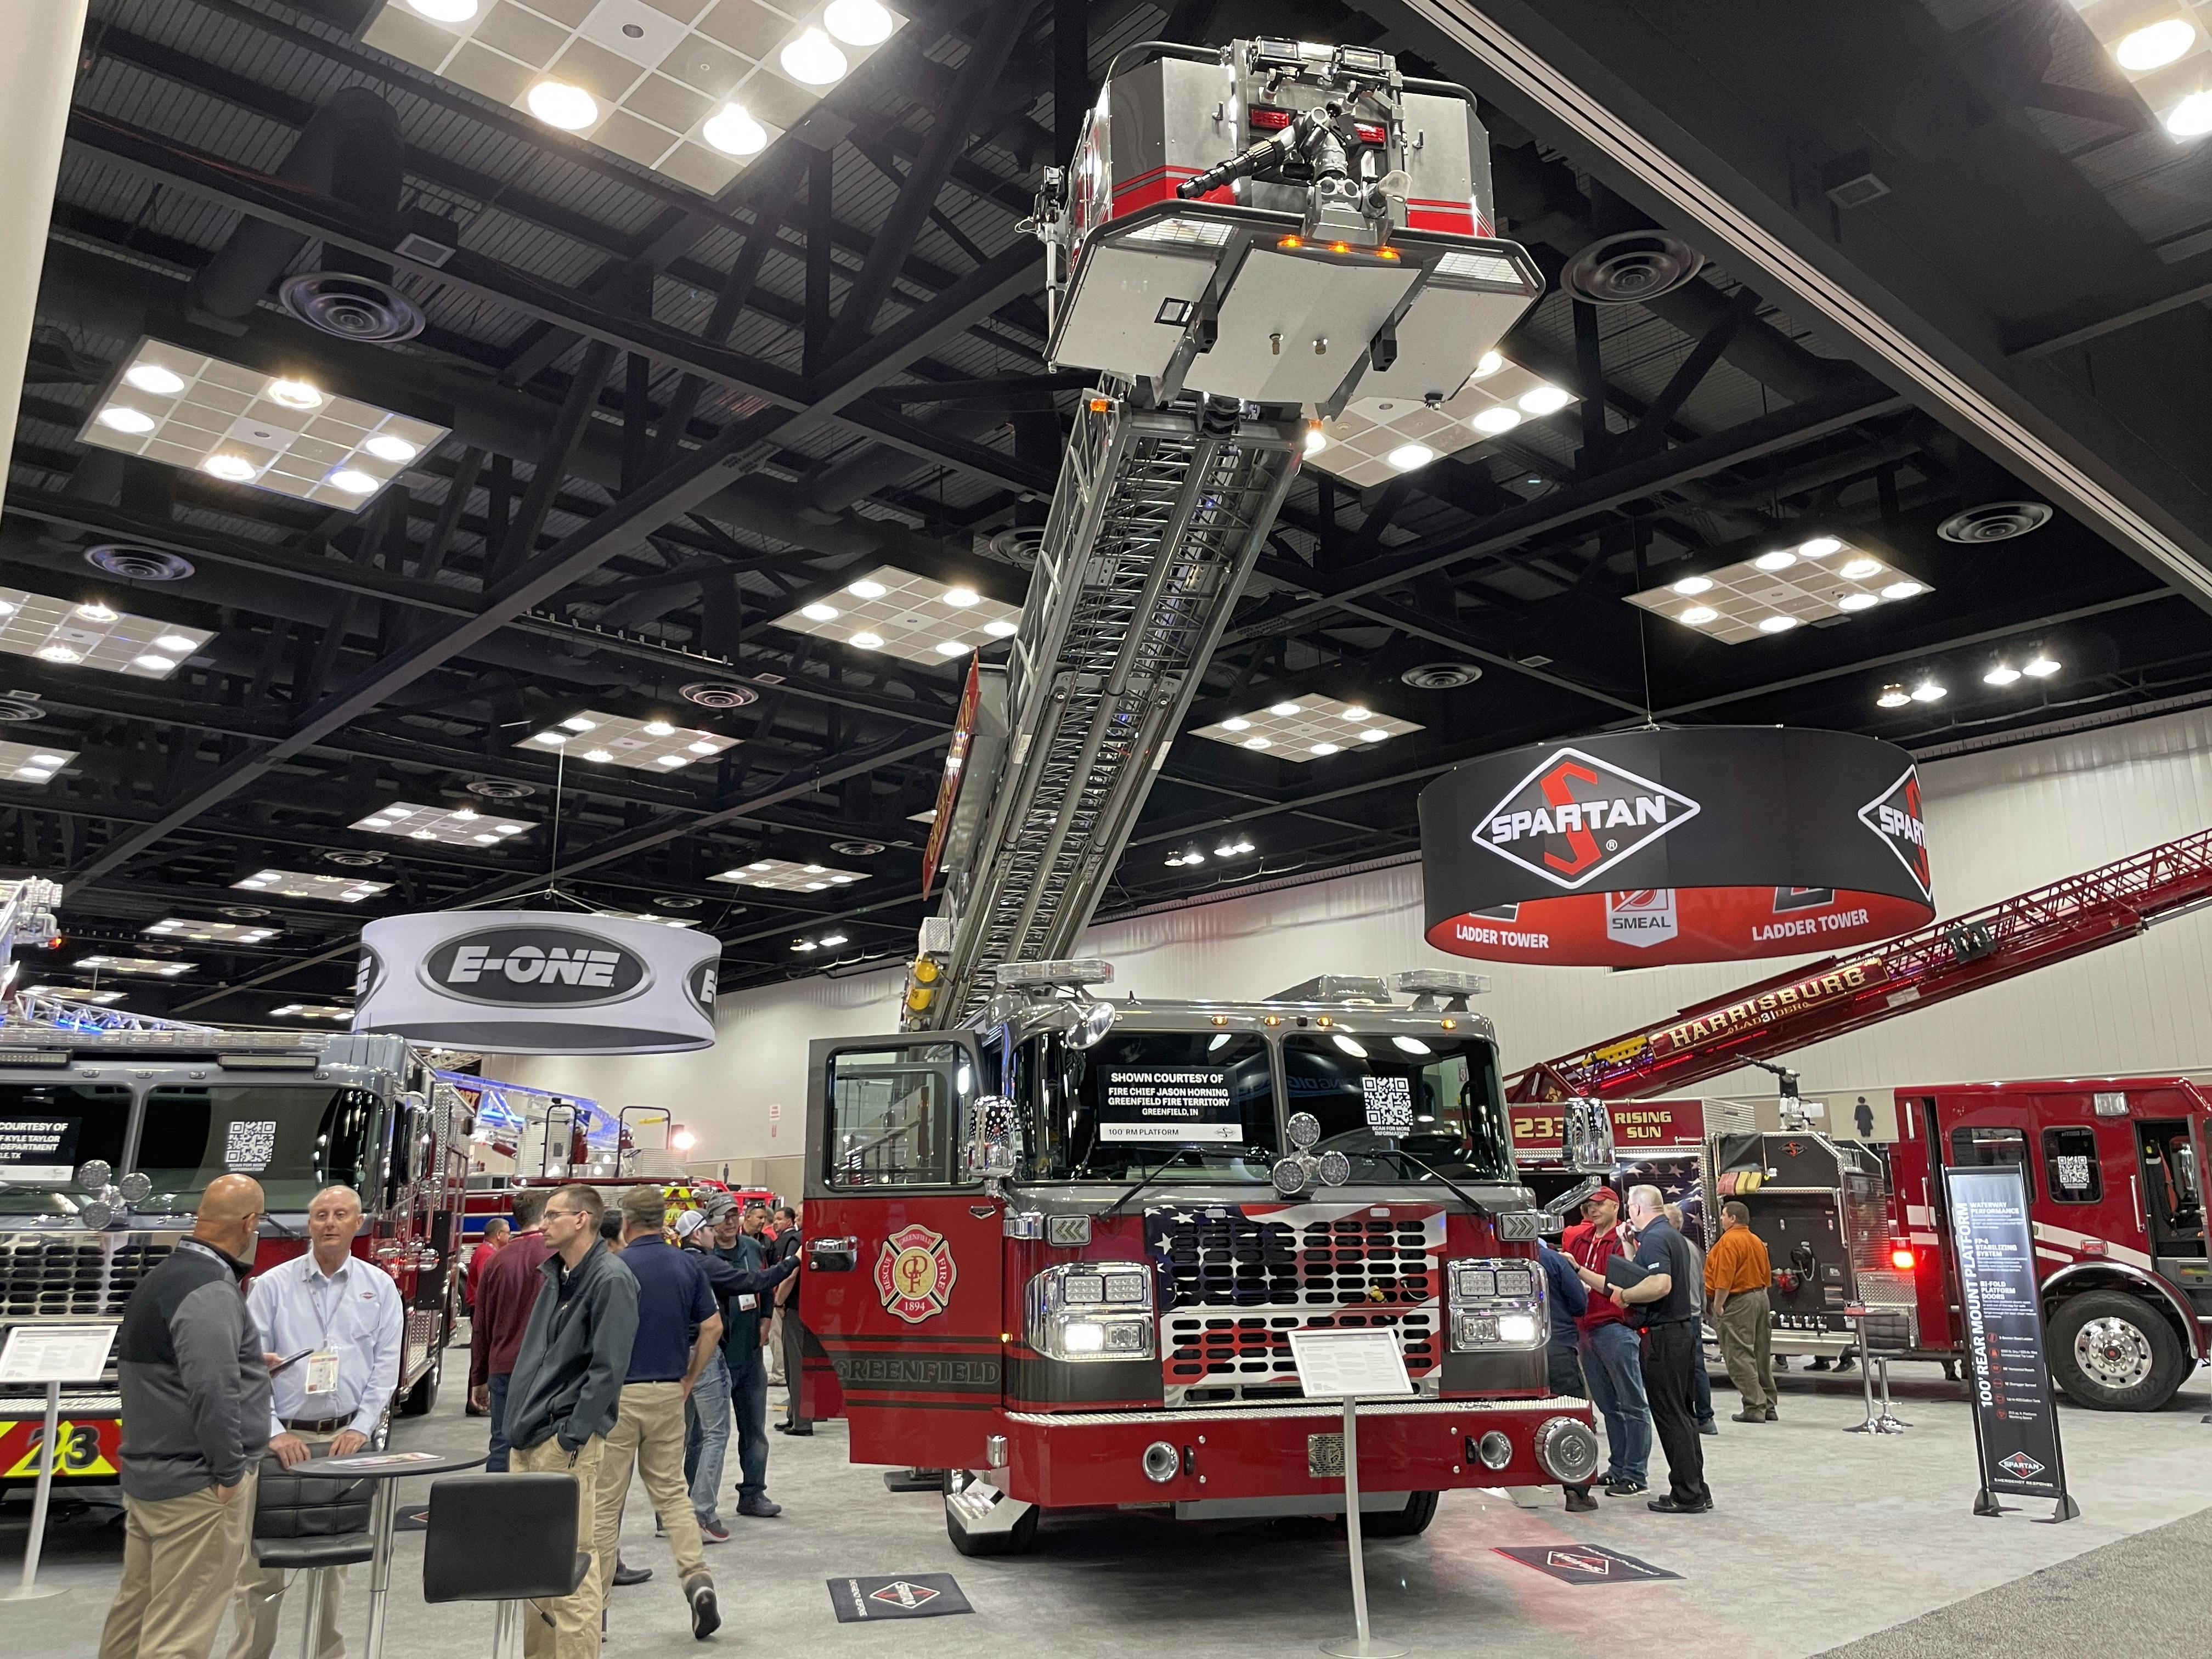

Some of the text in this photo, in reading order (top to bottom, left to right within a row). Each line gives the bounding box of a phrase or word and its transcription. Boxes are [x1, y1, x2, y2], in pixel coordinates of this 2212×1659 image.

[1491, 795, 1667, 844] SPARTAN
[1878, 804, 1927, 849] SPART
[1612, 916, 1671, 929] SMEAL
[1752, 909, 1869, 941] LADDER TOWER
[1456, 923, 1549, 949] LADDER TOWER
[446, 945, 621, 988] E-ONE
[1668, 967, 1866, 1048] HARRISBURG
[1111, 1072, 1224, 1084] SHOWN COURTESY OF
[1108, 1087, 1228, 1097] FIRE CHIEF JASON HORNING
[1108, 1097, 1230, 1107] GREENFIELD FIRE TERRITORY
[1142, 1108, 1189, 1116] GREENFIELD,
[1614, 1111, 1672, 1124] RISING
[0, 1122, 69, 1131] COURTESY OF
[1626, 1126, 1662, 1138] SUN
[898, 1233, 933, 1245] GREENFIELD
[882, 1256, 892, 1290] RESCUE
[938, 1257, 947, 1289] FIRE
[905, 1301, 926, 1311] 1894
[1955, 1203, 1993, 1408] 100' REAR MOUNT PLATFORM
[833, 1358, 1001, 1385] GREENFIELD
[24, 1425, 100, 1470] 23
[2004, 1461, 2039, 1470] SPARTAN
